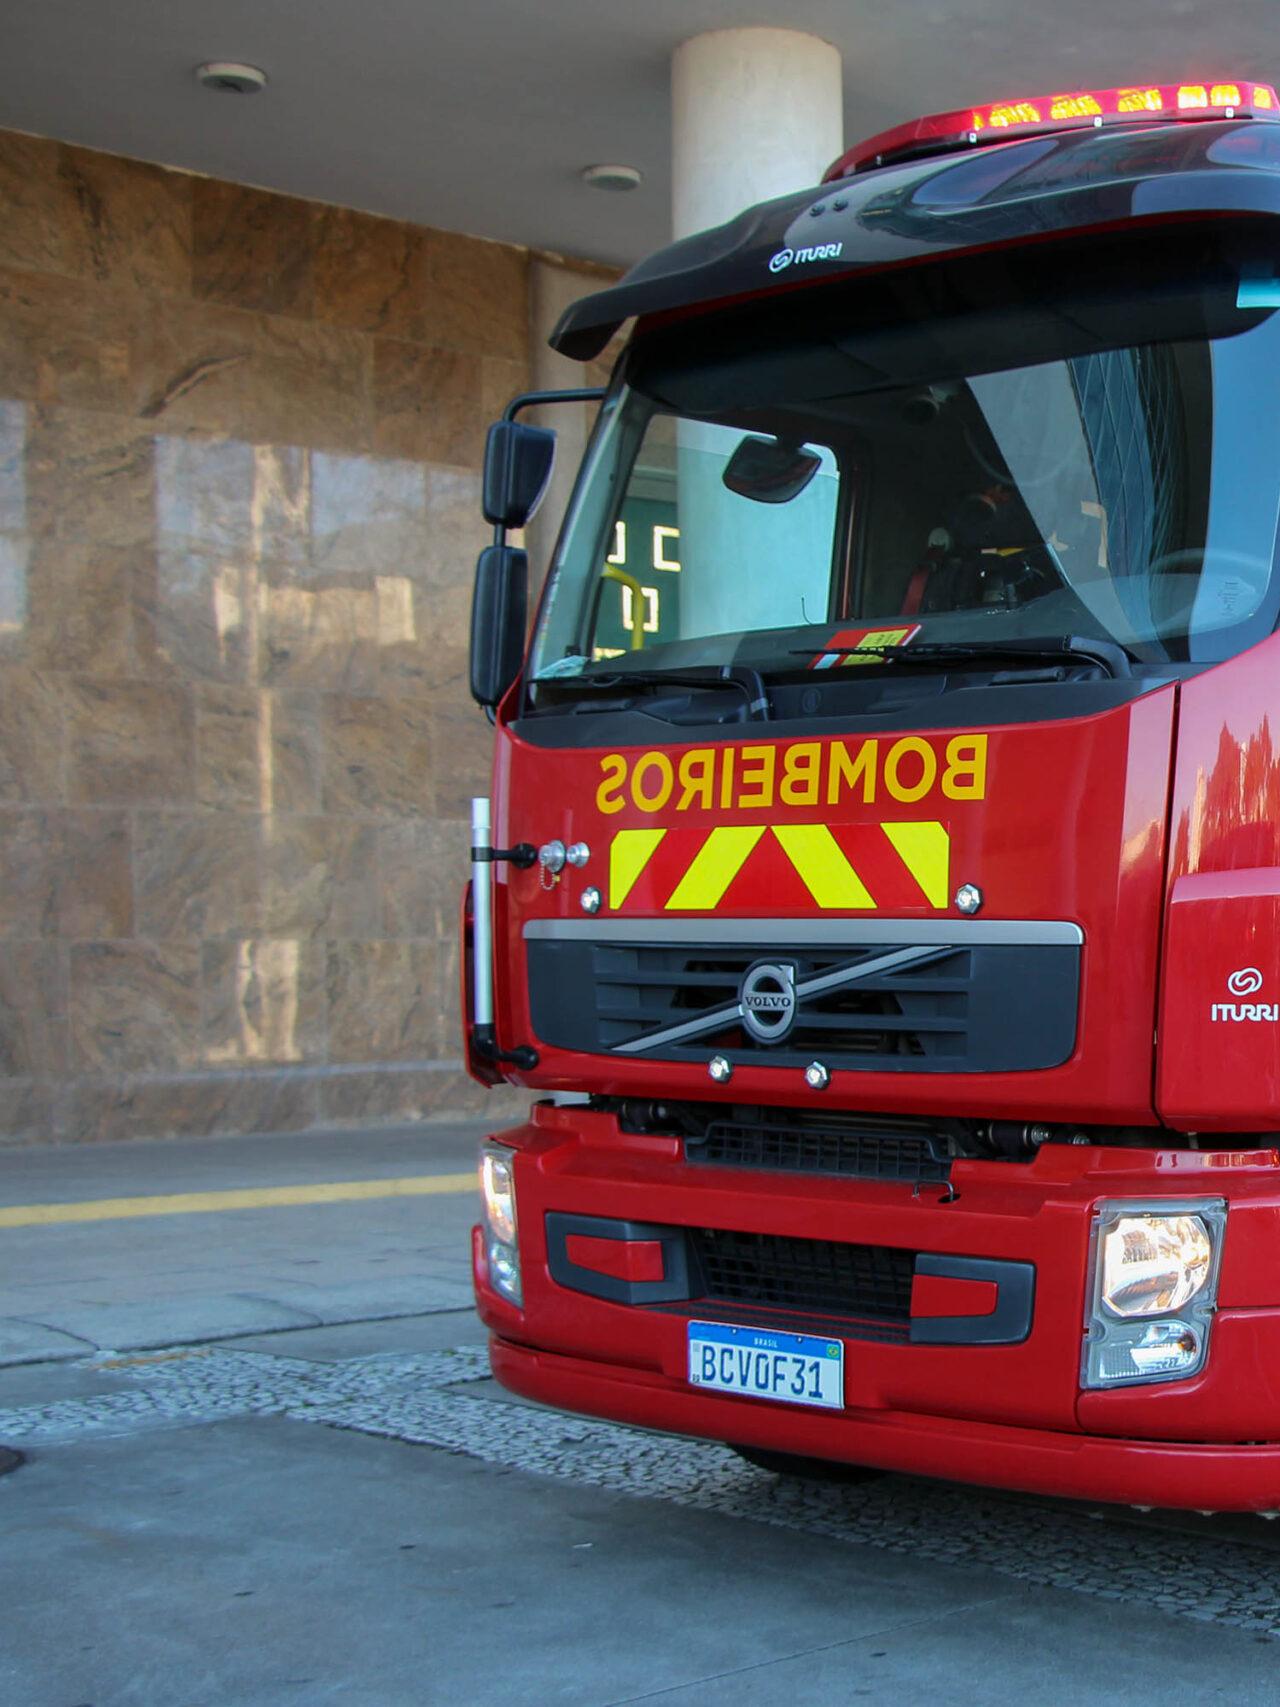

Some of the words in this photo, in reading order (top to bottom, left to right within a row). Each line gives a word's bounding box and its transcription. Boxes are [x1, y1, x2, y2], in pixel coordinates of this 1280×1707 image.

[794, 242, 843, 265] ITURRI
[744, 996, 791, 1007] VOLVO
[1211, 1003, 1279, 1022] ITURRI
[753, 1336, 779, 1349] BRASIL
[702, 1345, 823, 1399] BCV0F31
